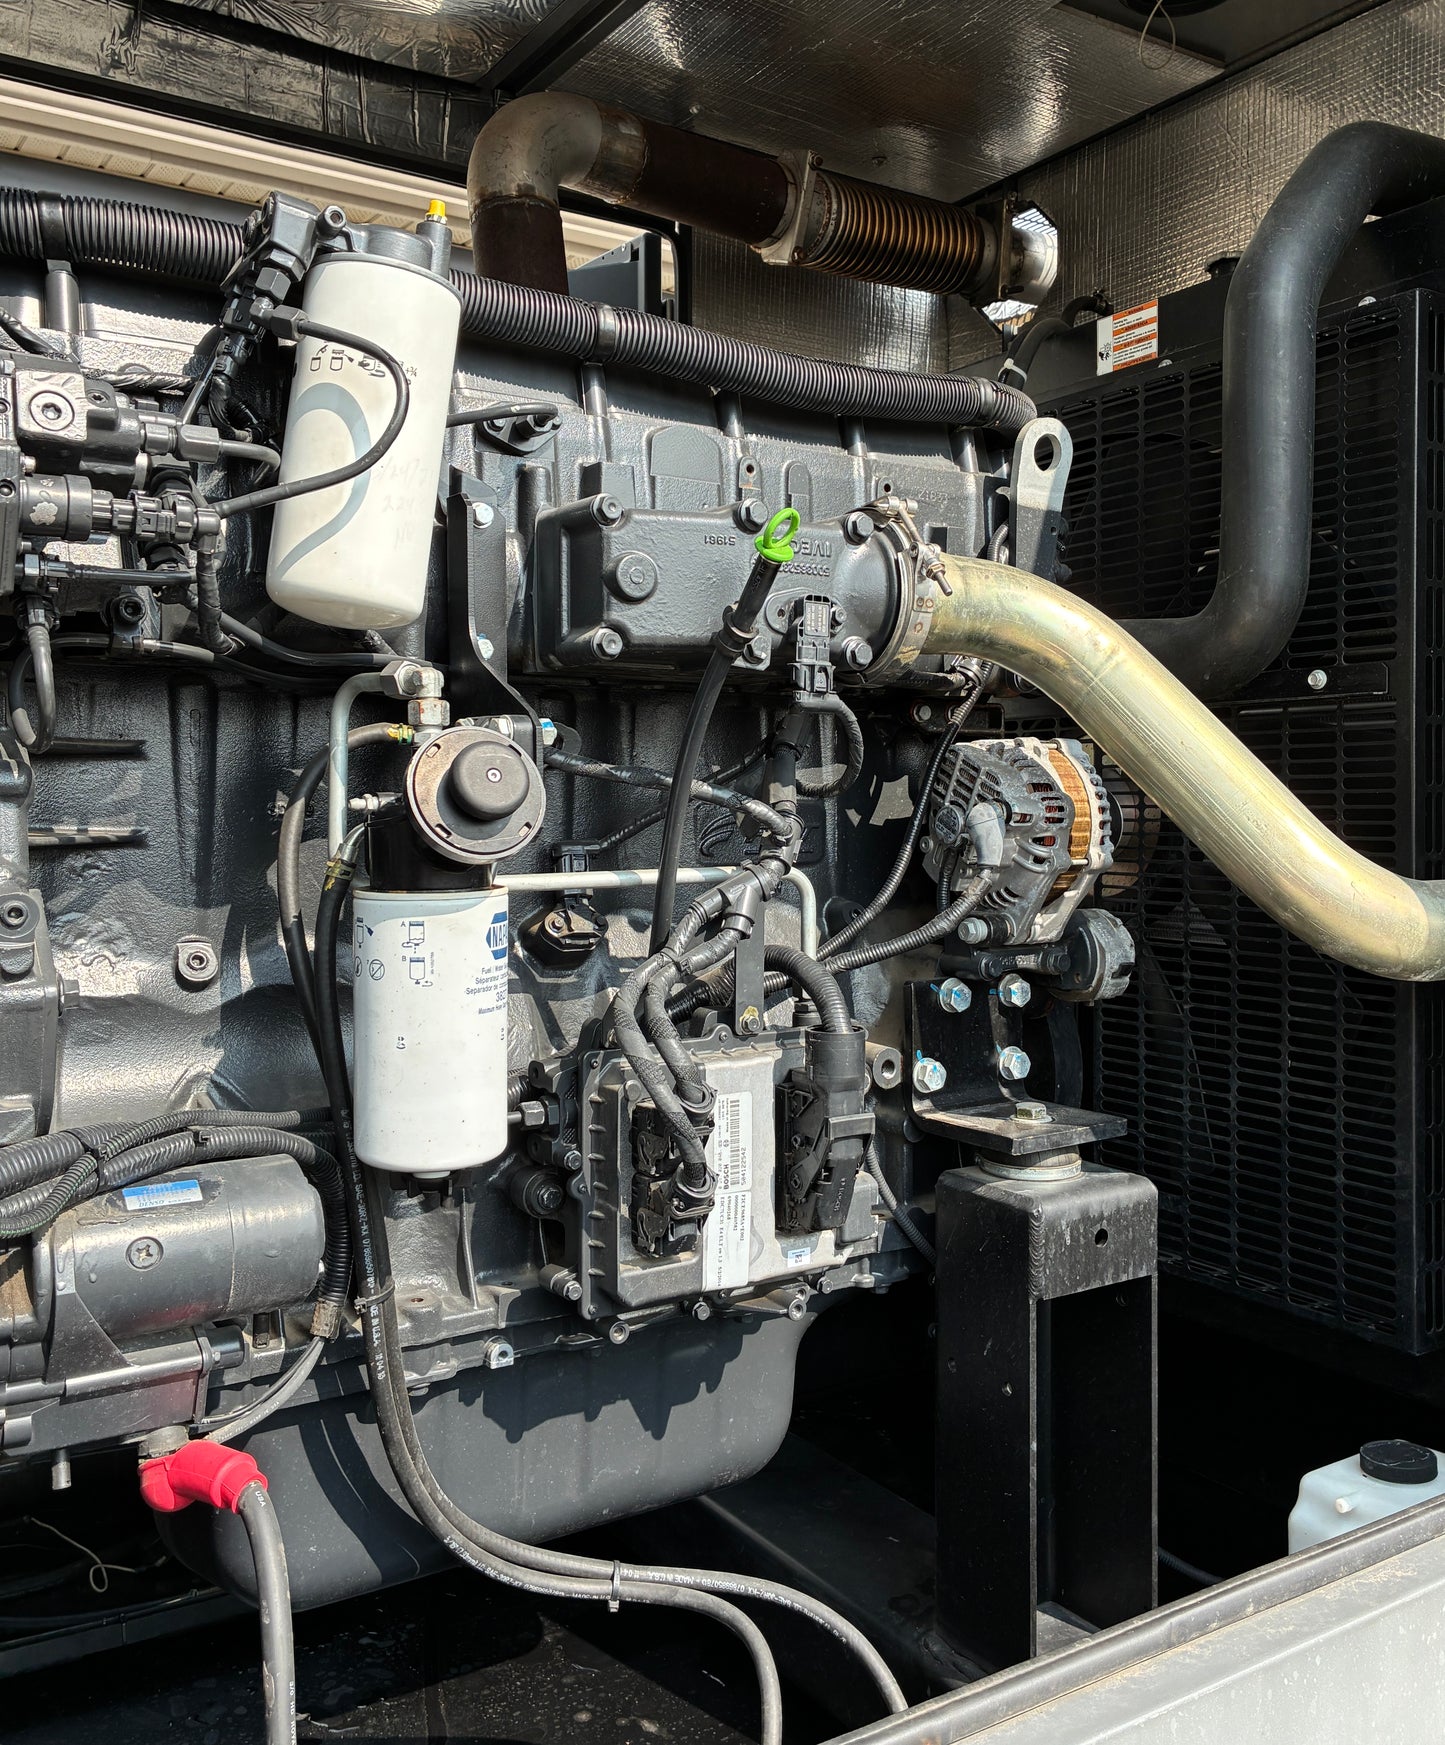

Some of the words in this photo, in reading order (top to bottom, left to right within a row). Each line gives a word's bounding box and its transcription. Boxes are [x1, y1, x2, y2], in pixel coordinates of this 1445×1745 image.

[789, 539, 833, 558] IVEC
[400, 920, 407, 928] A
[255, 1490, 266, 1507] USA
[674, 1574, 695, 1585] MADE
